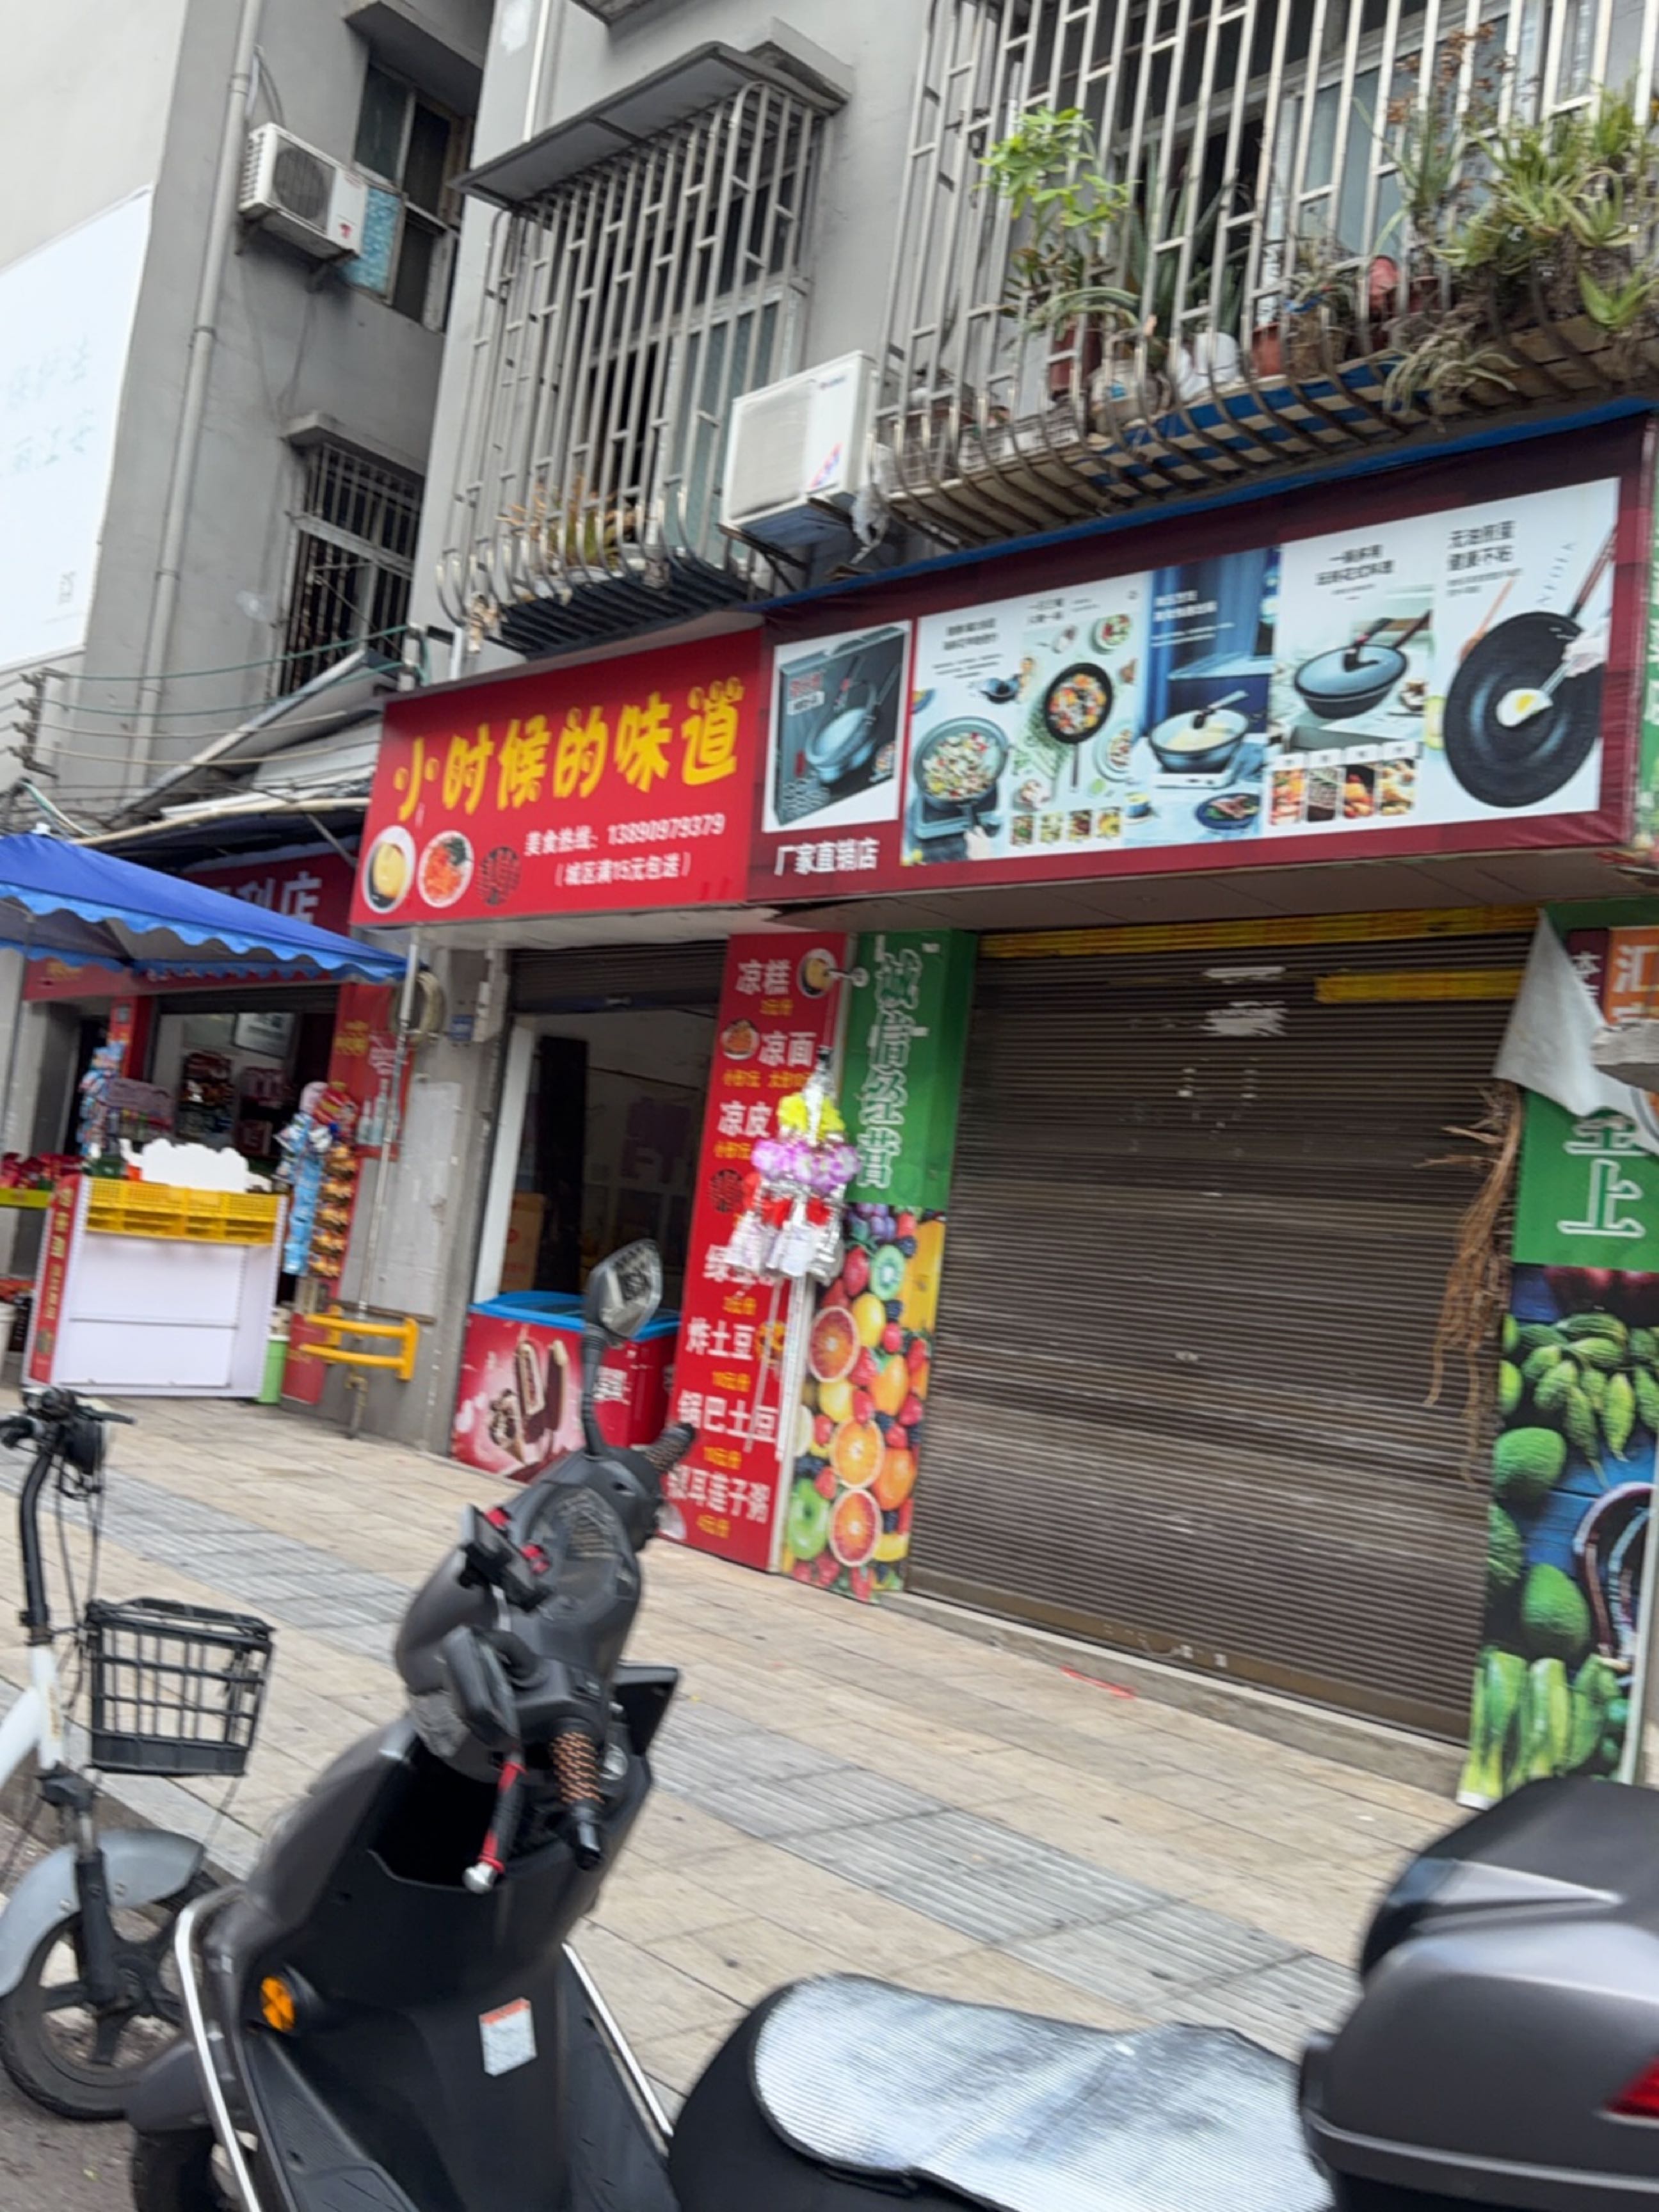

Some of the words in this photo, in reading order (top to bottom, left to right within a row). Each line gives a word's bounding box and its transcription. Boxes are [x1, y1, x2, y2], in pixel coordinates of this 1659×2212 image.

[393, 677, 745, 821] 小时候的味道
[774, 837, 880, 876] 厂家直销店
[758, 1031, 817, 1066] 凉面
[717, 1100, 772, 1137] 凉皮
